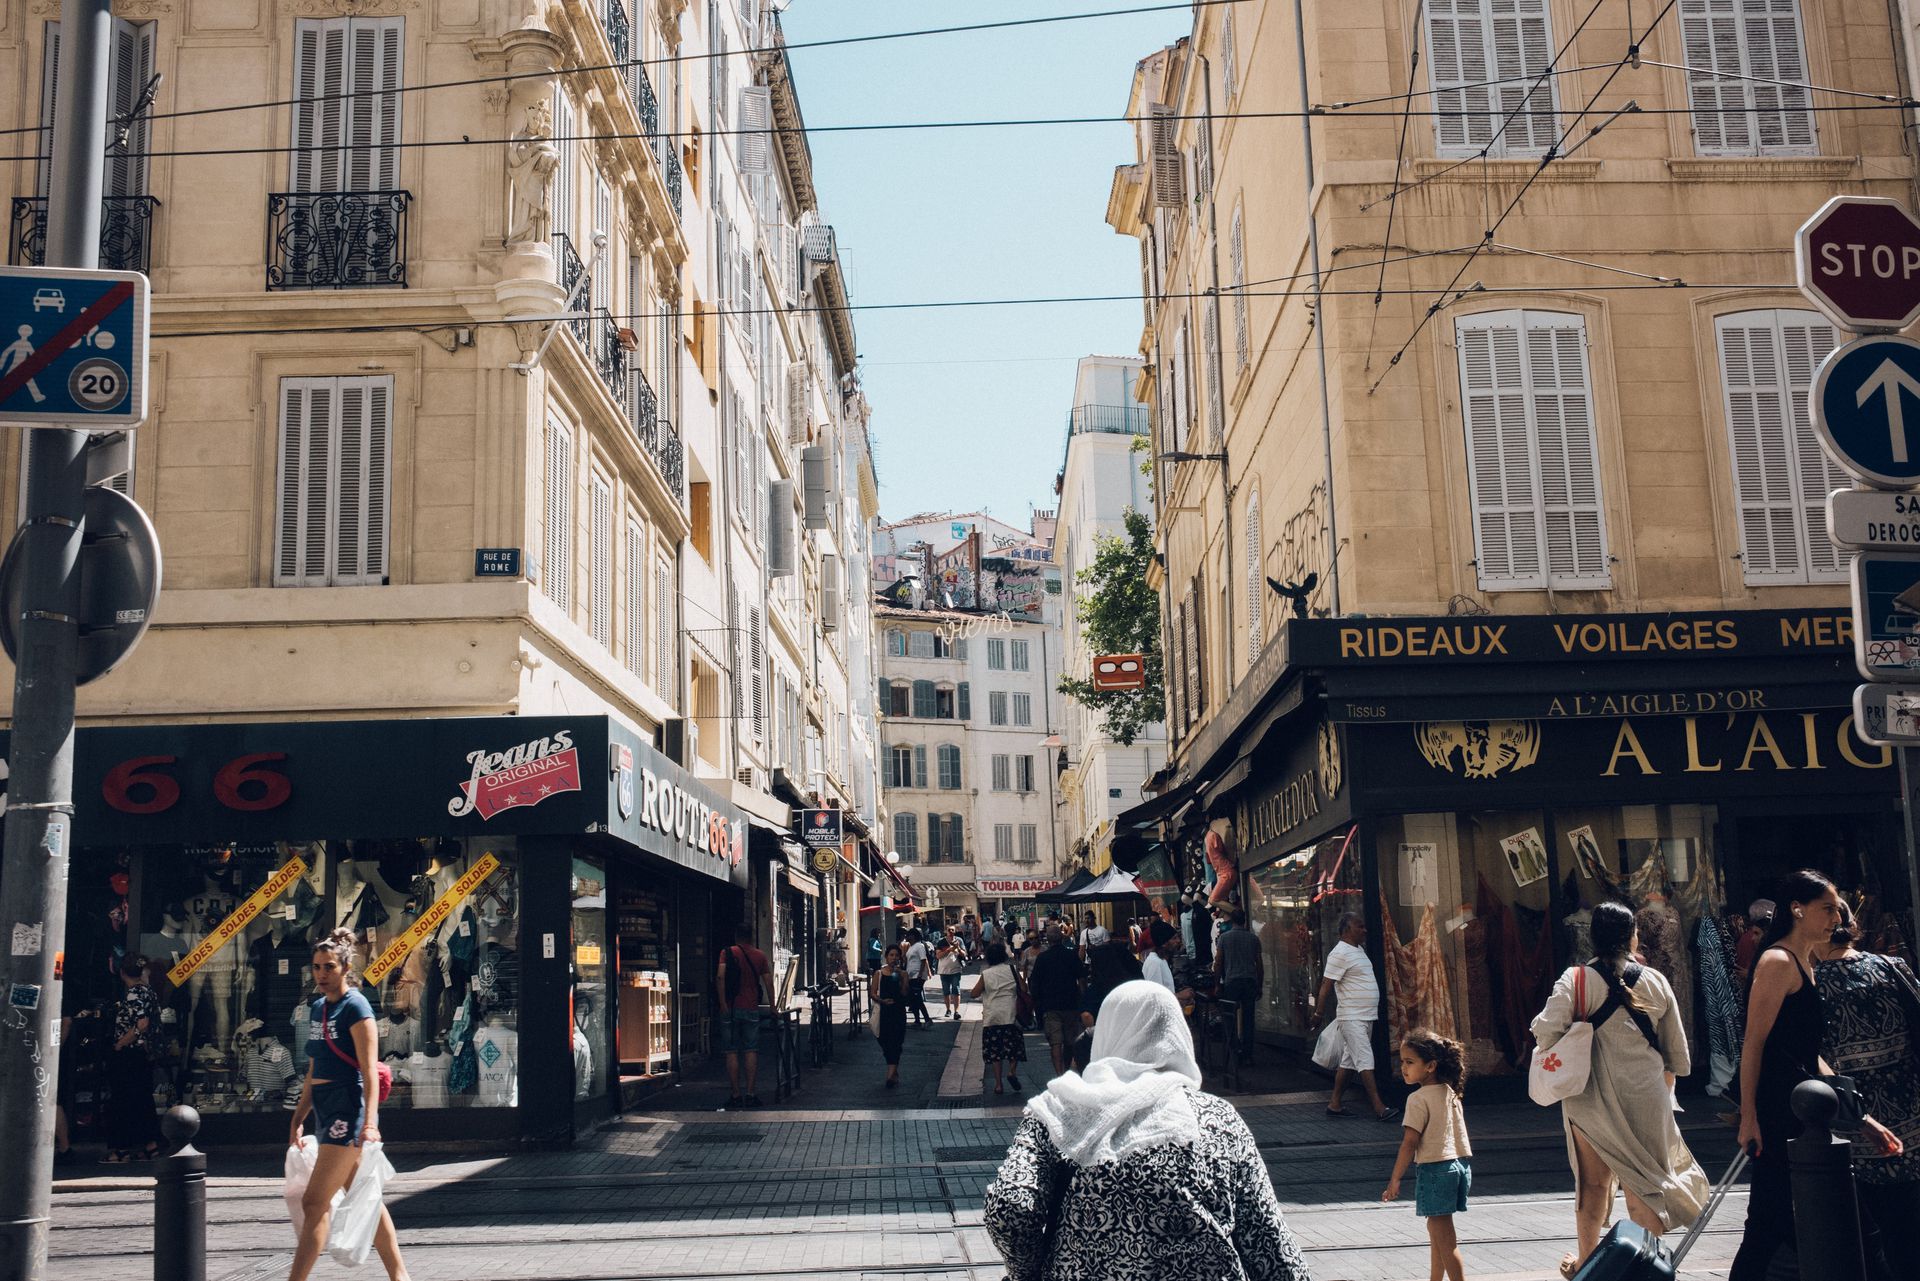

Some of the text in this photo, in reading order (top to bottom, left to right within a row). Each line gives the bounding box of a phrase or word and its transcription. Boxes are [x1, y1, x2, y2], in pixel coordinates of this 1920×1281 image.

[1821, 242, 1920, 280] STOP
[82, 374, 115, 394] 20
[1894, 495, 1920, 514] SA
[1868, 522, 1920, 542] DEROG
[484, 563, 510, 572] ROME
[1340, 624, 1508, 658] RIDEAUX
[1553, 620, 1738, 653] VOILAGES
[1346, 704, 1386, 718] Tissus
[1547, 697, 1568, 716] A
[1866, 705, 1886, 720] PRI
[1600, 718, 1662, 777] A
[448, 729, 573, 817] Jeans
[485, 755, 567, 787] ORIGINAL
[1253, 811, 1260, 849] A
[1402, 844, 1432, 852] Simplicity
[981, 881, 1019, 892] TOUBA
[176, 942, 213, 979] SOLDES
[220, 902, 257, 938] SOLDES
[263, 862, 300, 899] SOLDES
[372, 859, 492, 978] SOLDES SOLDES SOLDES
